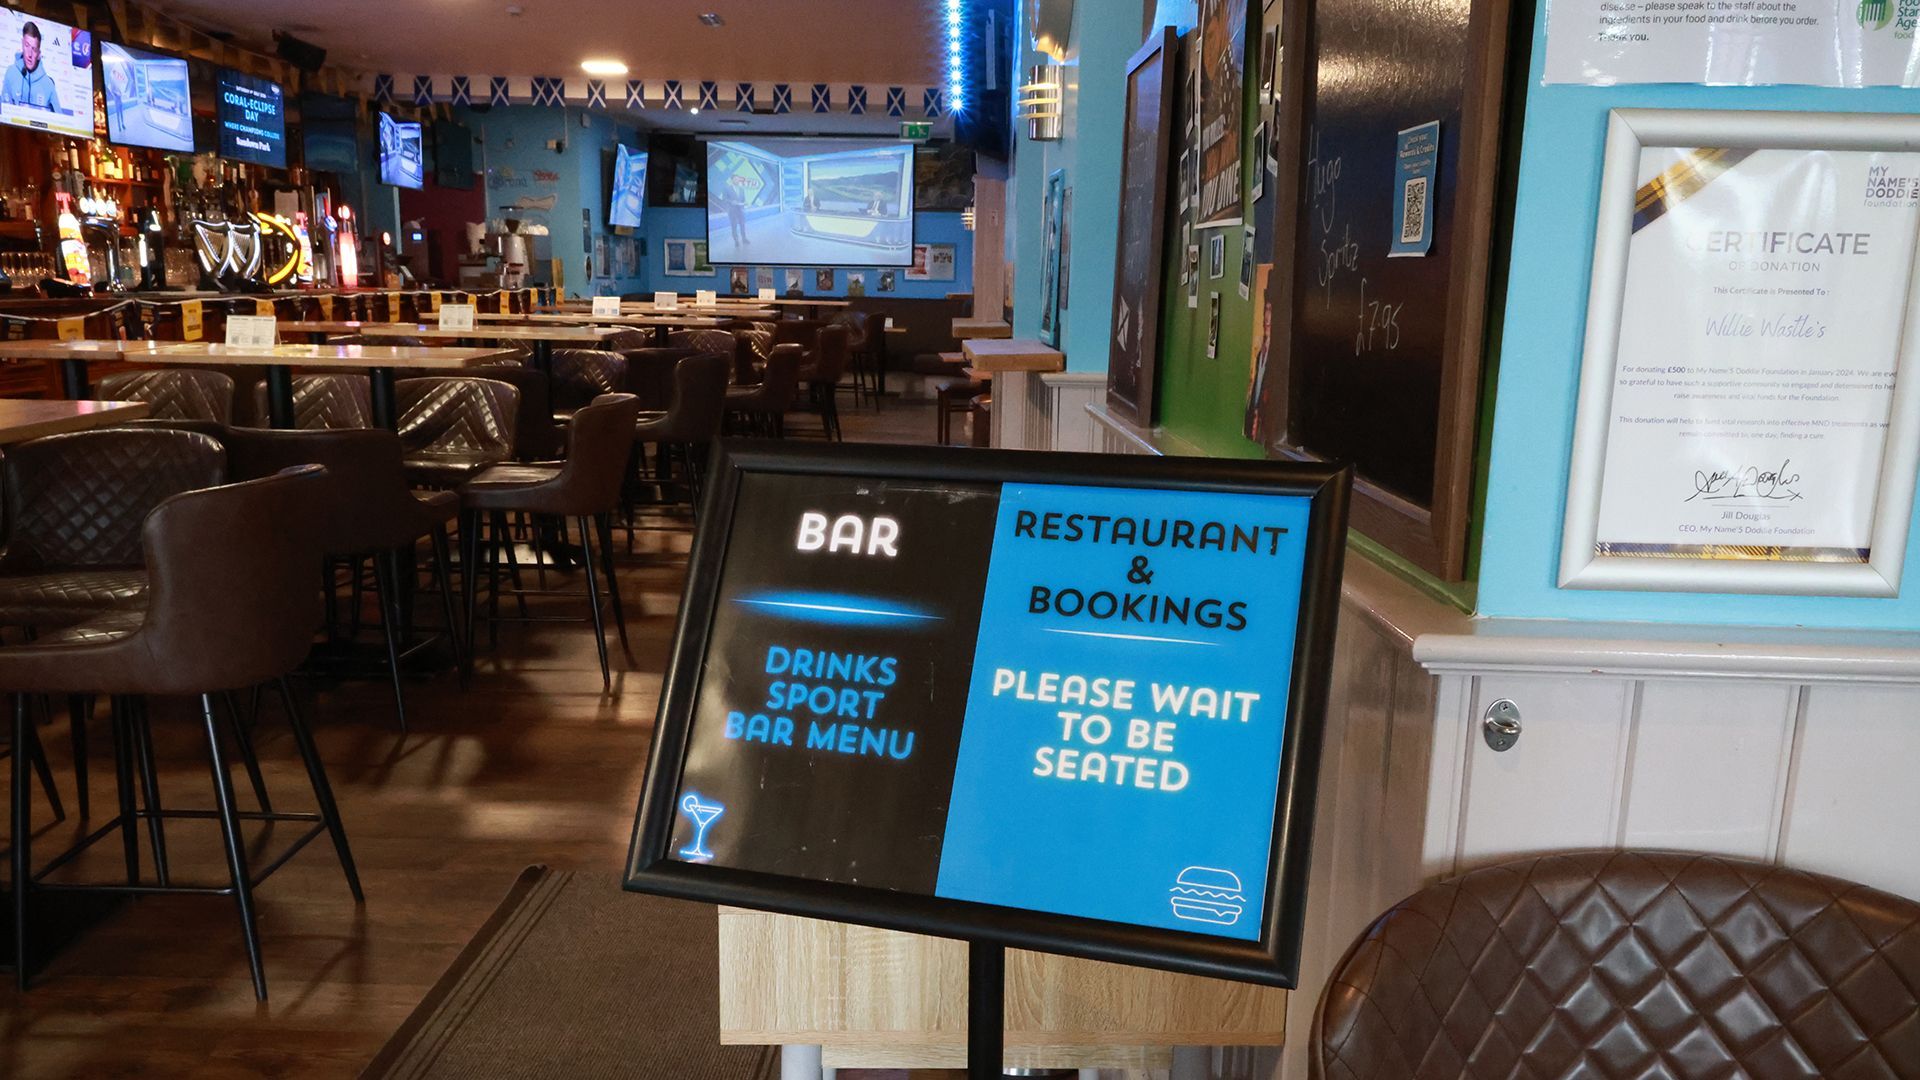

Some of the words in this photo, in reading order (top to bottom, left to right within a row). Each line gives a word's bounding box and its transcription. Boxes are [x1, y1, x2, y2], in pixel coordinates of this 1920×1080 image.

[1600, 2, 1636, 11] disease
[1645, 2, 1676, 12] please
[1678, 2, 1704, 12] speak
[1707, 2, 1716, 10] to
[1718, 2, 1732, 10] the
[1735, 2, 1755, 10] staff
[1756, 2, 1780, 11] about
[1783, 3, 1796, 12] the
[1600, 14, 1650, 24] ingredients
[1653, 14, 1661, 24] in
[1663, 16, 1683, 24] your
[1686, 14, 1706, 24] food
[1708, 14, 1724, 23] and
[1726, 14, 1748, 24] drink
[1750, 15, 1778, 24] before
[1780, 17, 1794, 26] you
[1796, 16, 1819, 26] order.
[1599, 32, 1628, 41] Tank
[224, 92, 276, 115] CORAL-ECLIPSE
[245, 110, 258, 122] DAY
[1869, 166, 1889, 176] MY
[1868, 178, 1919, 188] NAME'S
[1866, 188, 1920, 198] DODDIE
[1686, 232, 1870, 254] CERIFICATE
[1750, 261, 1820, 272] DONATION
[1713, 286, 1728, 294] This
[1778, 288, 1815, 296] Presented
[1816, 288, 1826, 296] To
[1706, 312, 1754, 337] Willie
[1636, 366, 1666, 374] donating
[1668, 366, 1686, 374] £500
[1634, 416, 1665, 424] donation
[1721, 512, 1733, 520] Jill
[797, 512, 899, 558] BAR
[1015, 510, 1290, 556] RESTAURANT
[1679, 524, 1698, 532] CEO,
[1700, 526, 1714, 534] My
[1126, 555, 1155, 585] &
[1028, 585, 1248, 632] BOOKINGS
[765, 645, 898, 687] DRINKS
[765, 682, 885, 718] SPORT
[992, 669, 1135, 711] PLEASE
[1149, 683, 1261, 723] WAIT
[724, 711, 794, 746] BAR
[806, 724, 916, 760] MENU
[1057, 711, 1113, 745] TO
[1127, 718, 1177, 753] BE
[1033, 747, 1190, 792] SEATED
